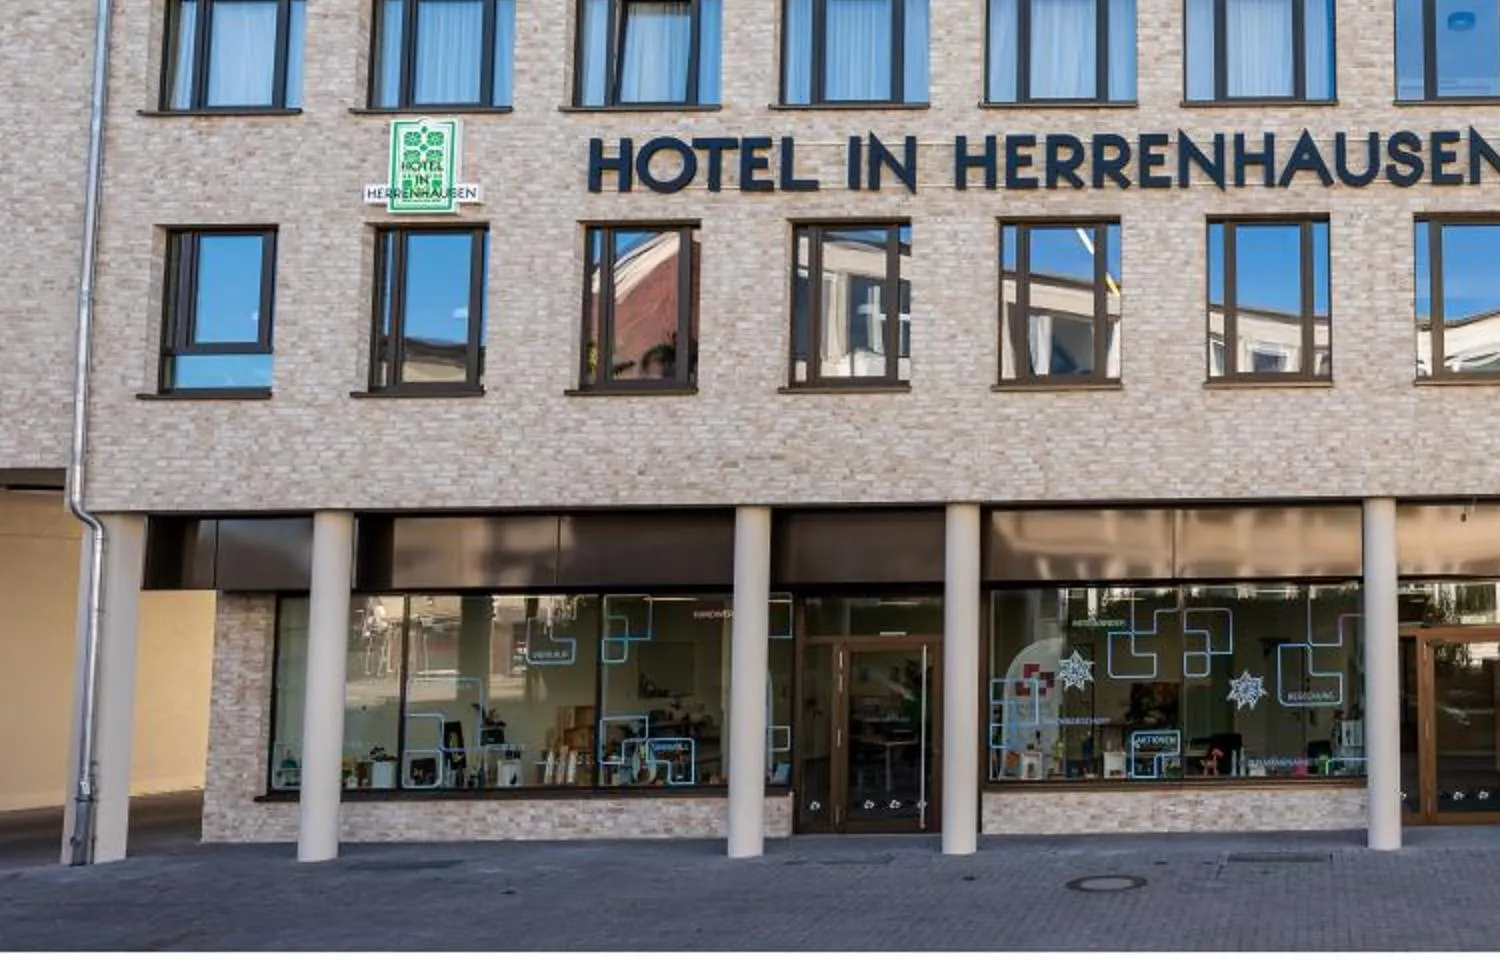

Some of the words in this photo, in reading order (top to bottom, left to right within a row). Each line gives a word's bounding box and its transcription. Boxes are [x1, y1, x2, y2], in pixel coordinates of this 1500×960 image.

[401, 161, 444, 171] HOTEL
[587, 136, 819, 194] HOTEL
[847, 134, 917, 195] IN
[415, 175, 429, 185] IN
[367, 187, 477, 199] HERRENHAUSEN
